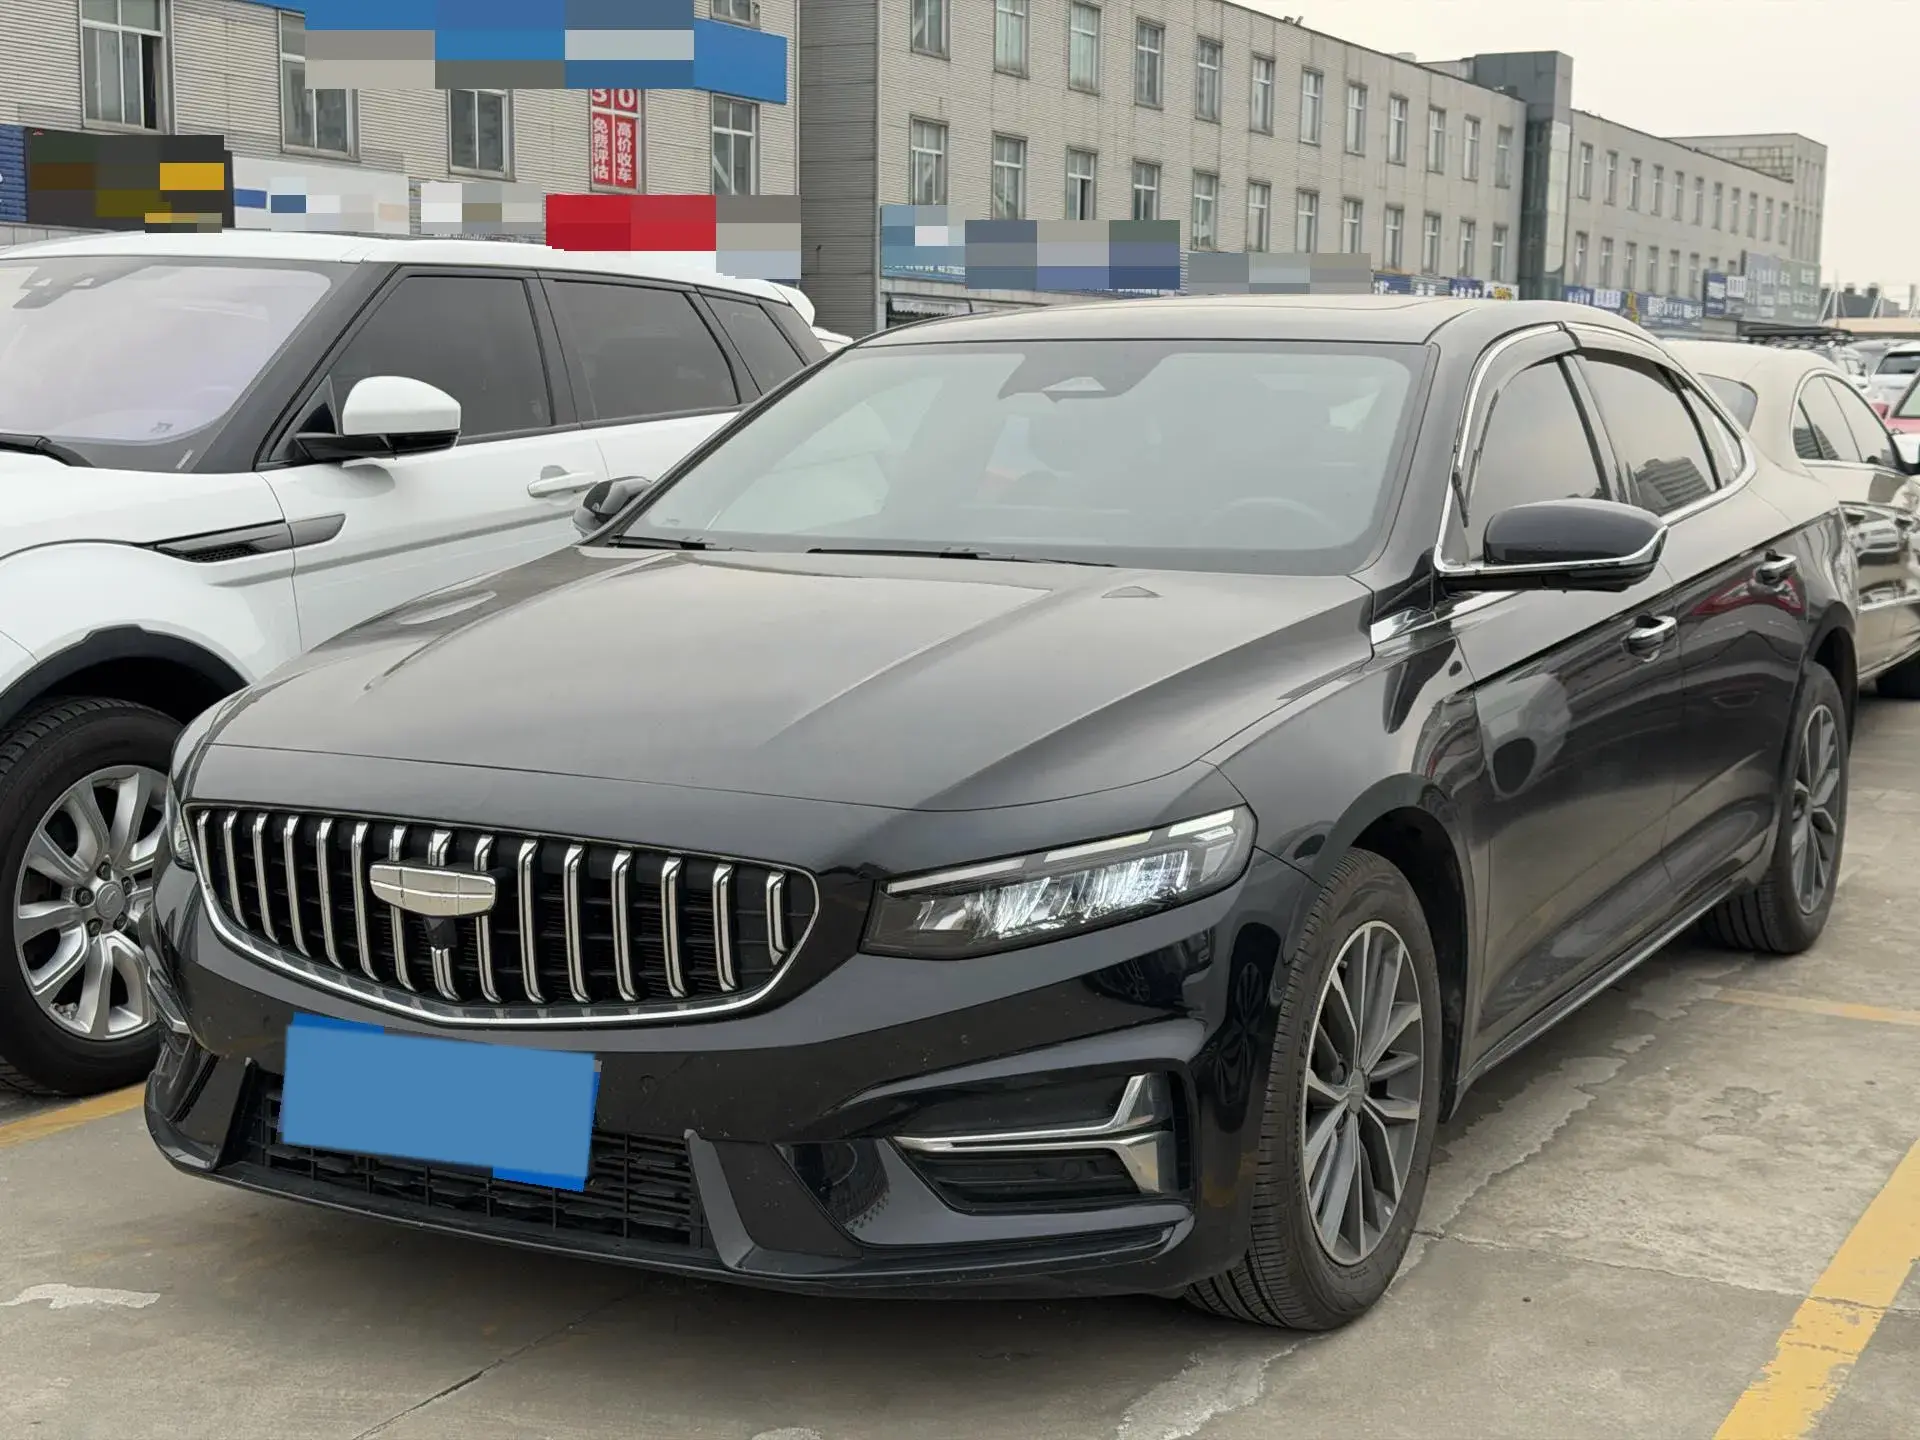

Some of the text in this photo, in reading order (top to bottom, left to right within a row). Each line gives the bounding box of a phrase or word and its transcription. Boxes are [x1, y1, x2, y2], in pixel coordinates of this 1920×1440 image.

[593, 117, 609, 181] 免费评估
[617, 122, 632, 183] 高价收车
